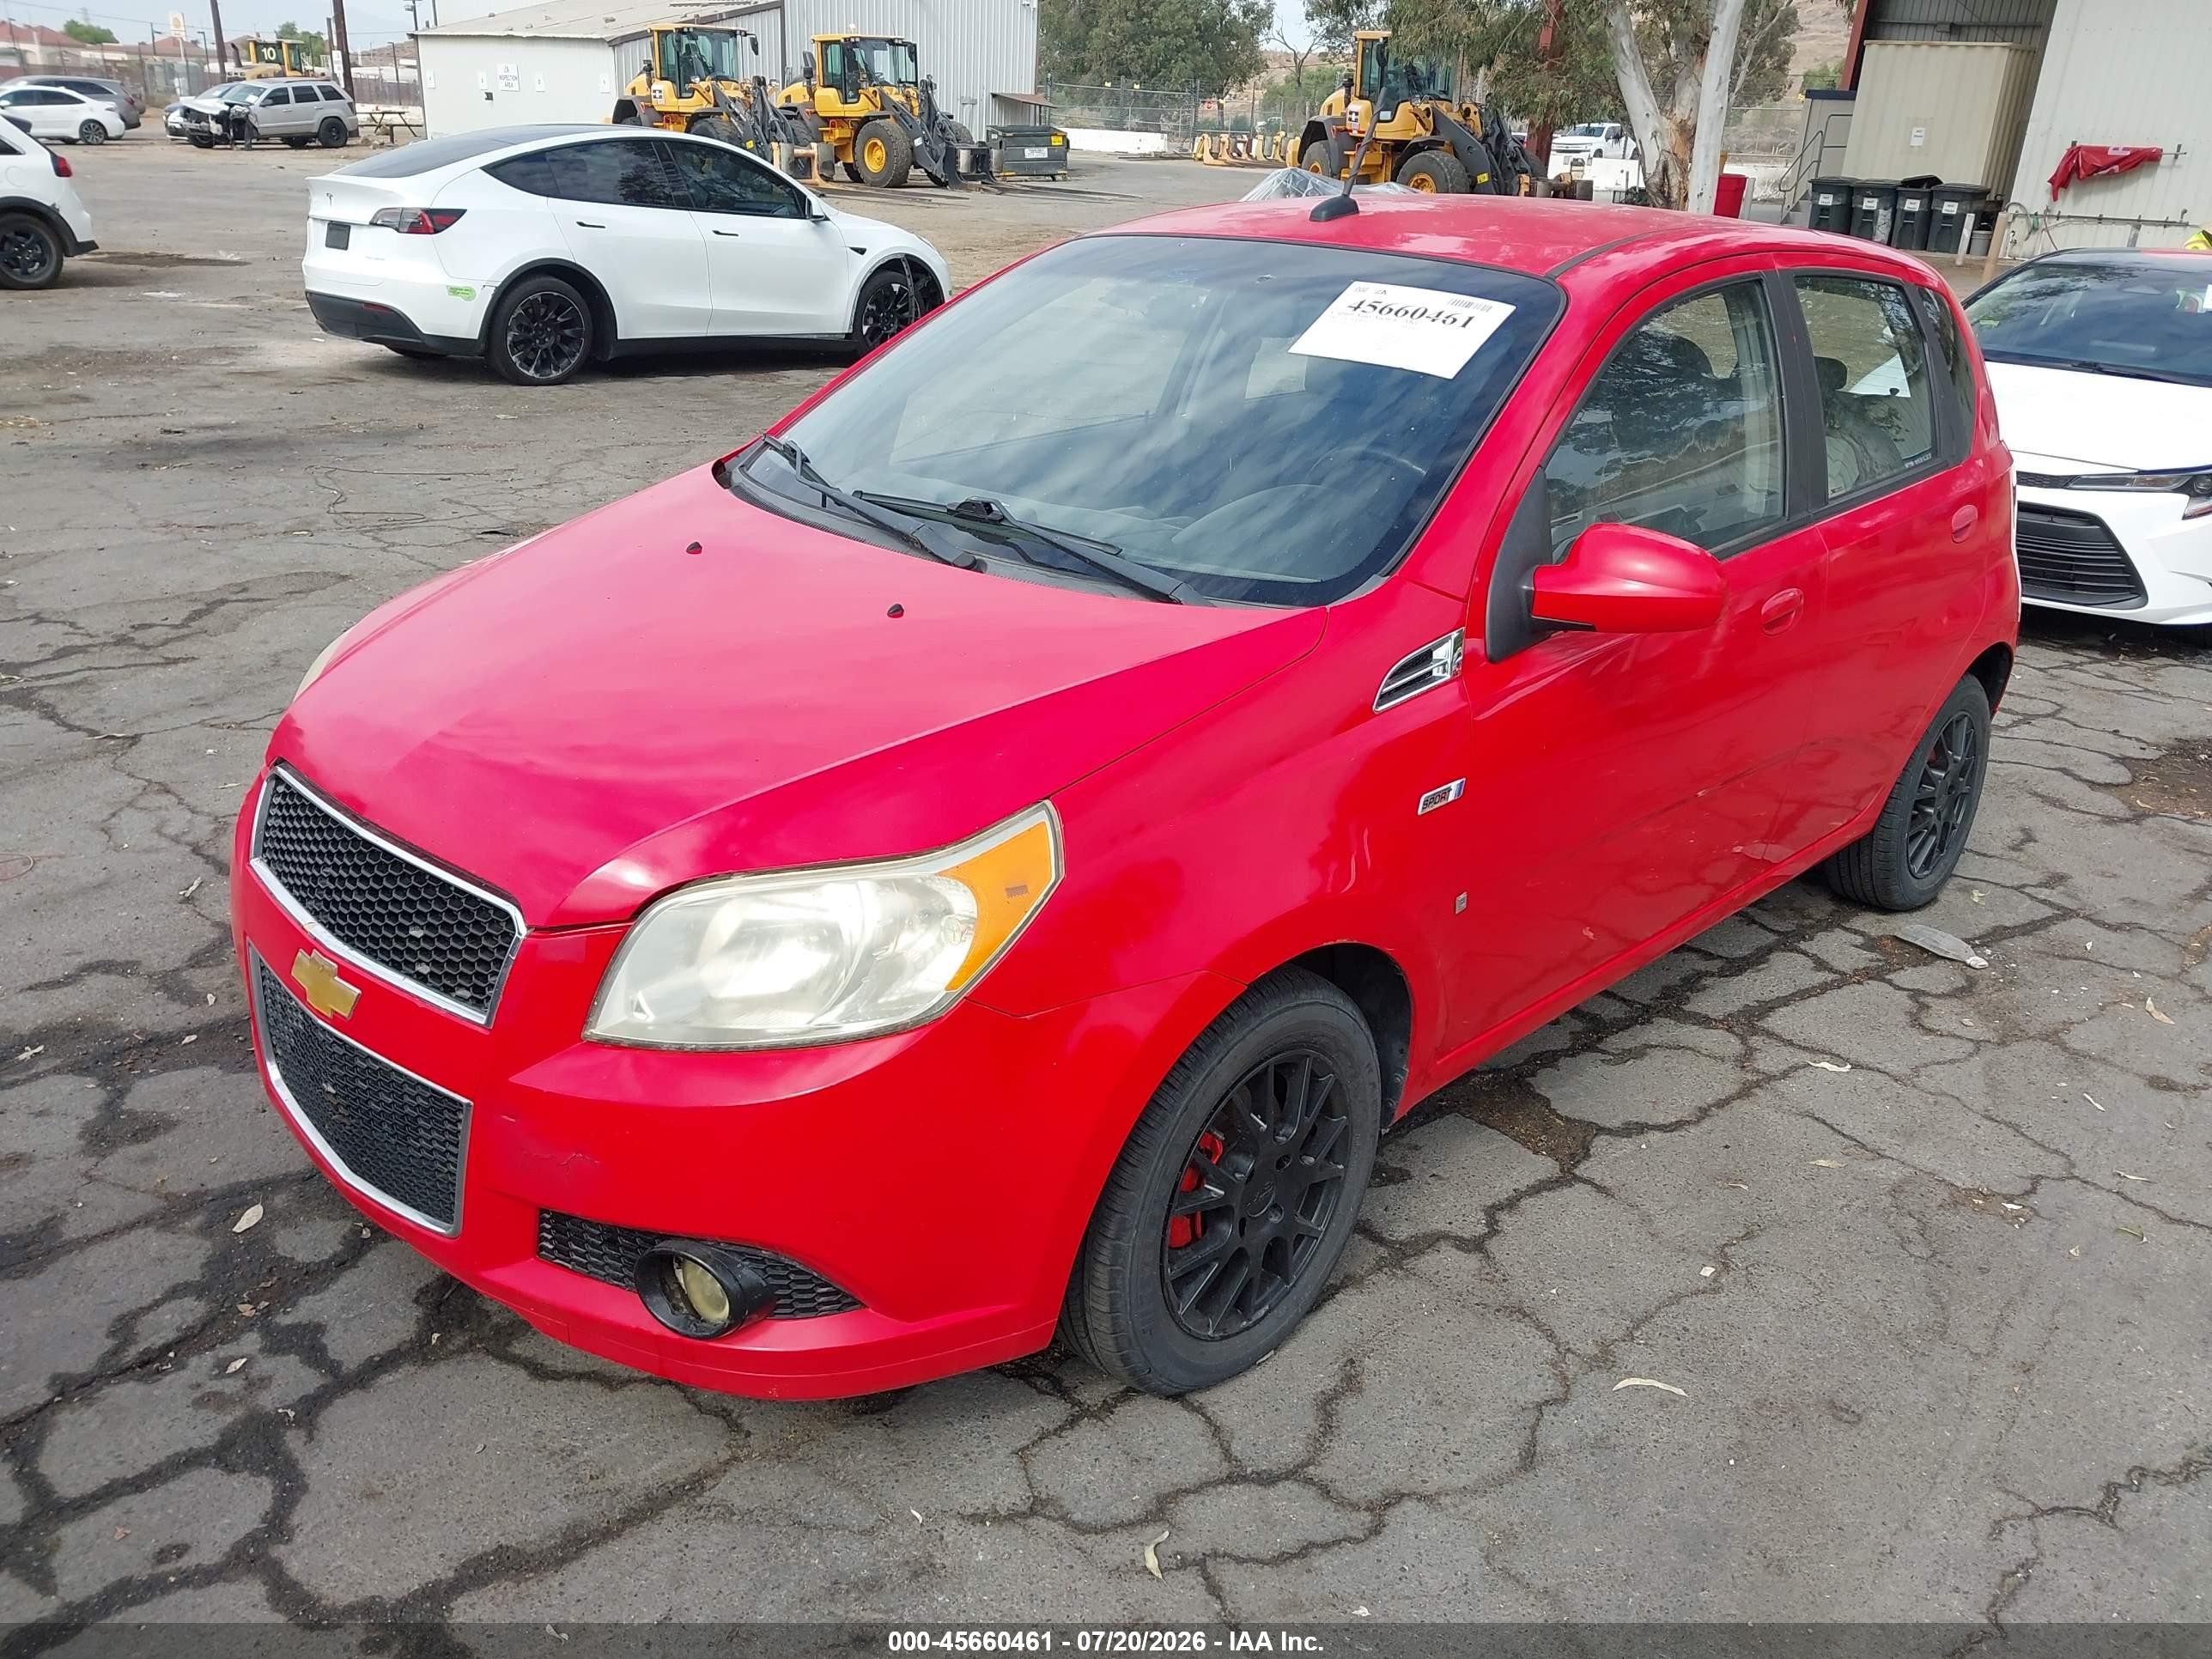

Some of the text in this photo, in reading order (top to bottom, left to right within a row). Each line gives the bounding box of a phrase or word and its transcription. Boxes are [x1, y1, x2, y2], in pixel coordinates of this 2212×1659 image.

[261, 47, 276, 60] 10
[1347, 299, 1475, 329] 45660461
[1421, 787, 1452, 811] SPORT
